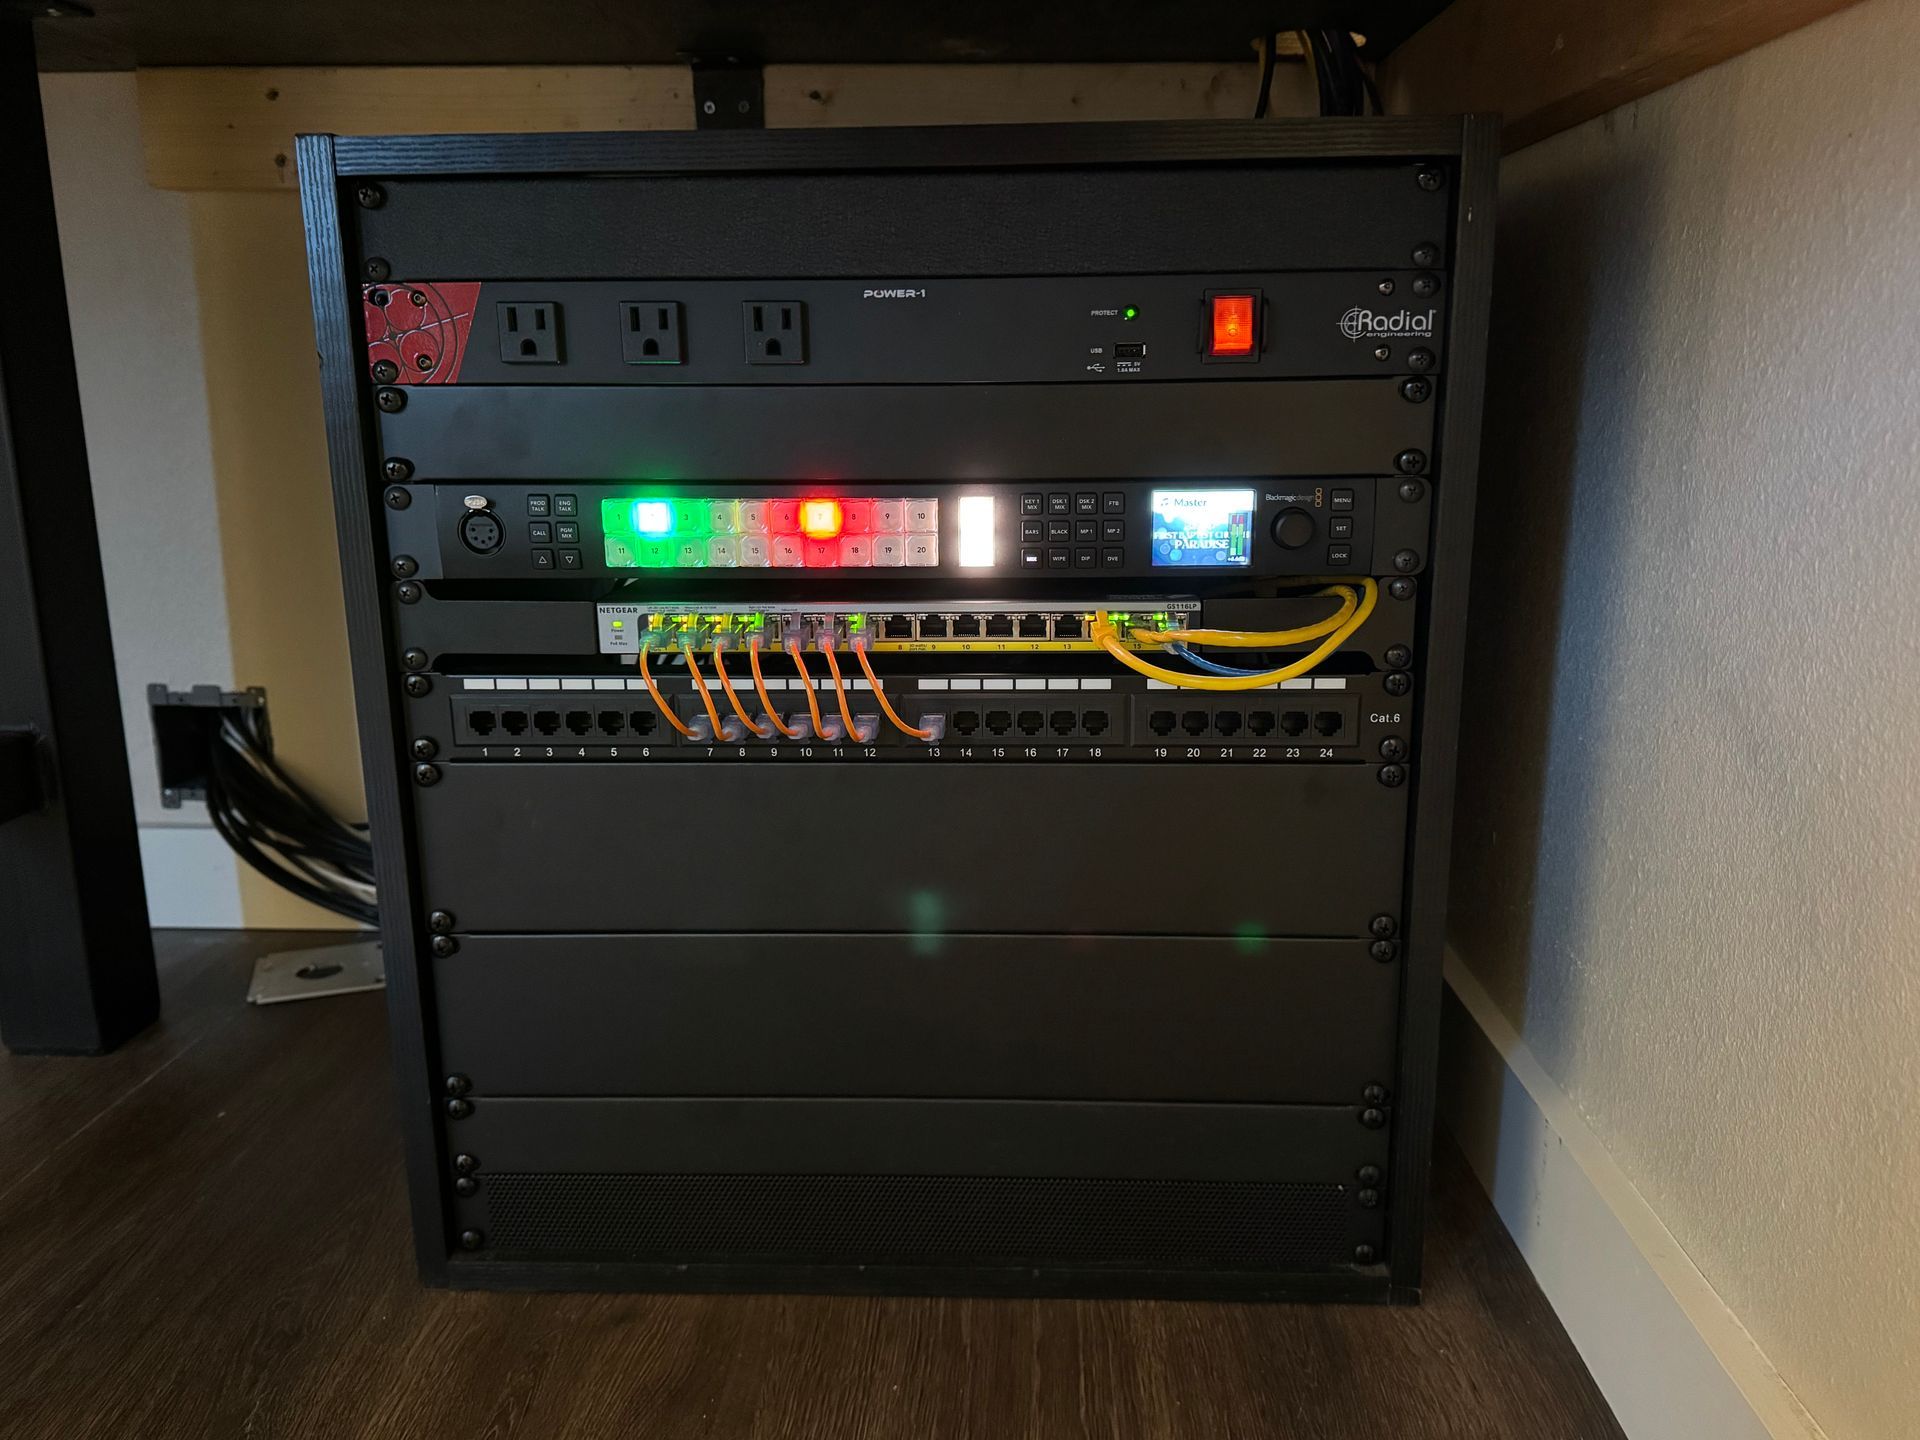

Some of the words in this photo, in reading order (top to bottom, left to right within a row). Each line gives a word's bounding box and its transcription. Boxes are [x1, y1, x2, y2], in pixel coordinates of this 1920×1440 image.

[863, 288, 926, 298] POWER-1
[1358, 309, 1433, 331] Radial
[1174, 498, 1207, 507] Master
[1174, 539, 1230, 549] PARADISE
[1370, 713, 1400, 723] Cat.6
[482, 748, 488, 757] 1
[514, 748, 521, 757] 2
[546, 748, 553, 757] 3
[578, 748, 585, 757] 4
[611, 748, 618, 757] 5
[642, 748, 650, 757] 6
[707, 748, 713, 757] 7
[739, 748, 746, 757] 8
[771, 748, 778, 757] 9
[800, 748, 813, 757] 10
[833, 748, 844, 757] 11
[864, 748, 876, 757] 12
[928, 748, 940, 757] 13
[960, 748, 972, 757] 14
[992, 748, 1005, 757] 15
[1024, 748, 1037, 757] 16
[1056, 748, 1069, 757] 17
[1089, 748, 1102, 757] 18
[1154, 748, 1167, 757] 19
[1187, 748, 1200, 757] 20
[1220, 748, 1233, 757] 21
[1253, 748, 1266, 757] 22
[1286, 748, 1300, 757] 23
[1320, 748, 1333, 757] 24
